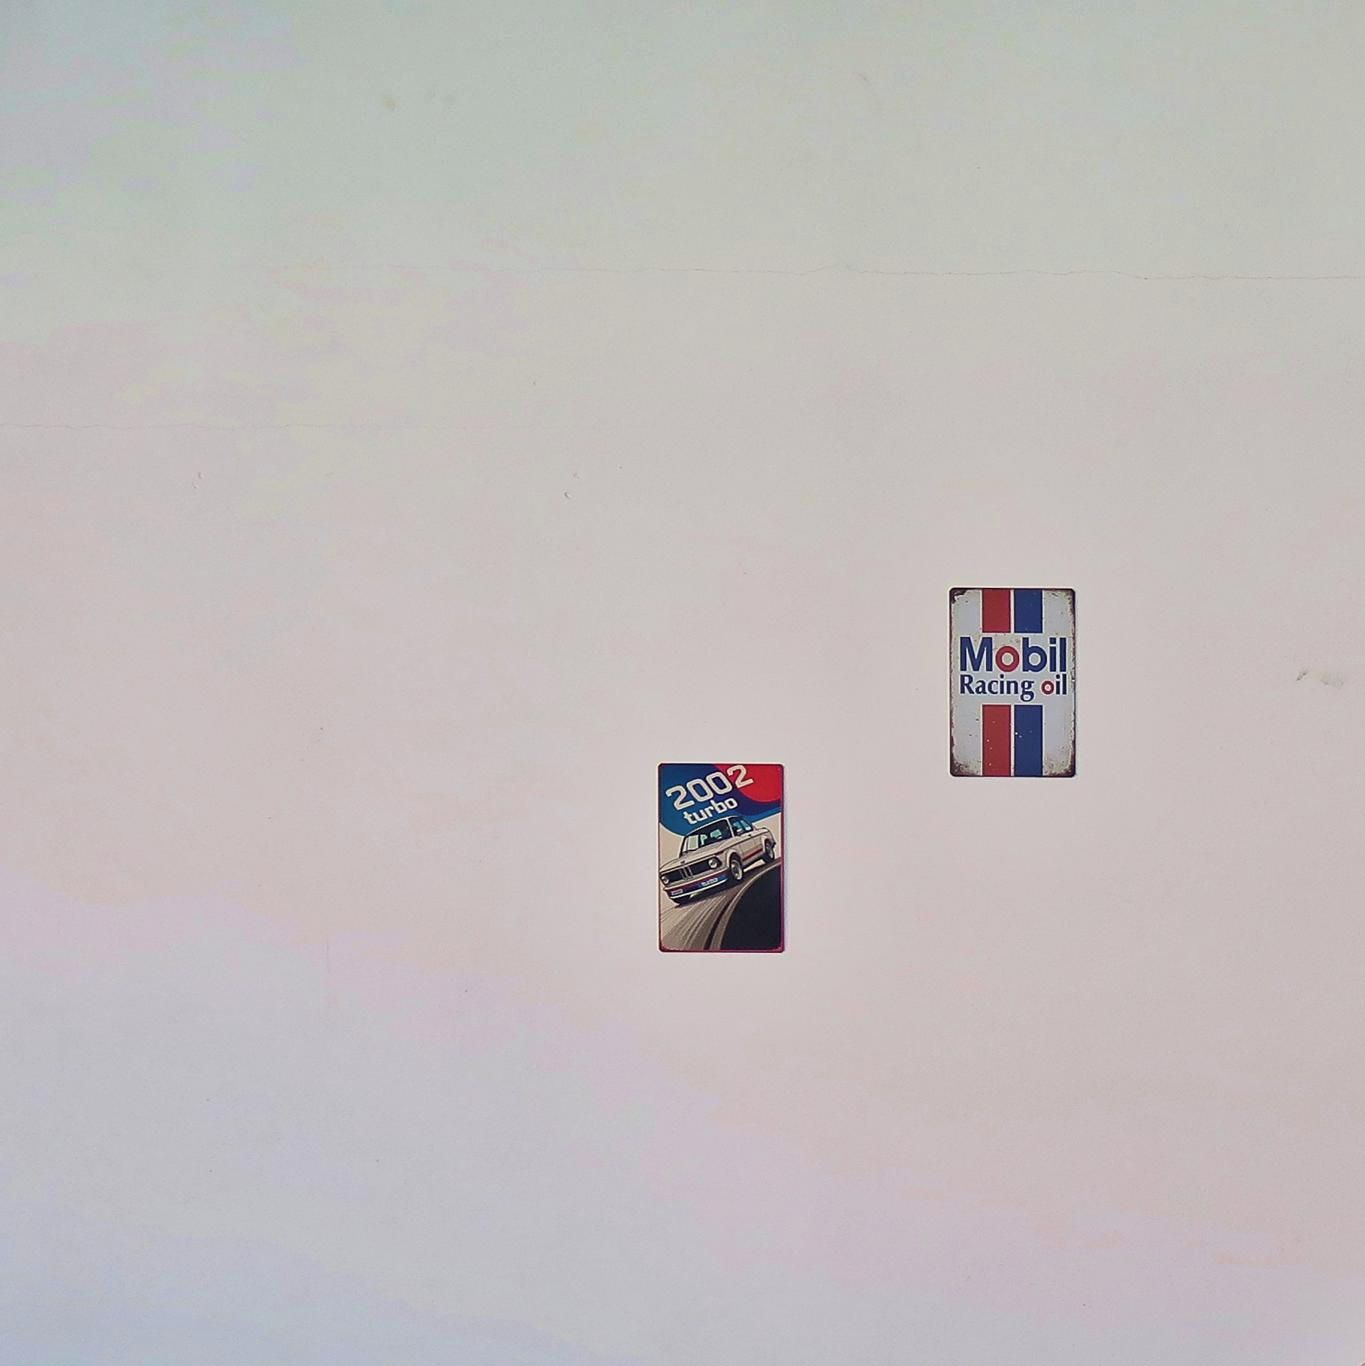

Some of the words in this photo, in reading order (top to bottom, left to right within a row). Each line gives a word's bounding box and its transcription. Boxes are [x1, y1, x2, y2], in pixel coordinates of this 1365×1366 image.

[959, 636, 1067, 672] Mobil
[959, 674, 1035, 702] Racing
[1041, 674, 1067, 695] oil
[665, 764, 754, 811] 2002
[683, 797, 738, 825] turbo
